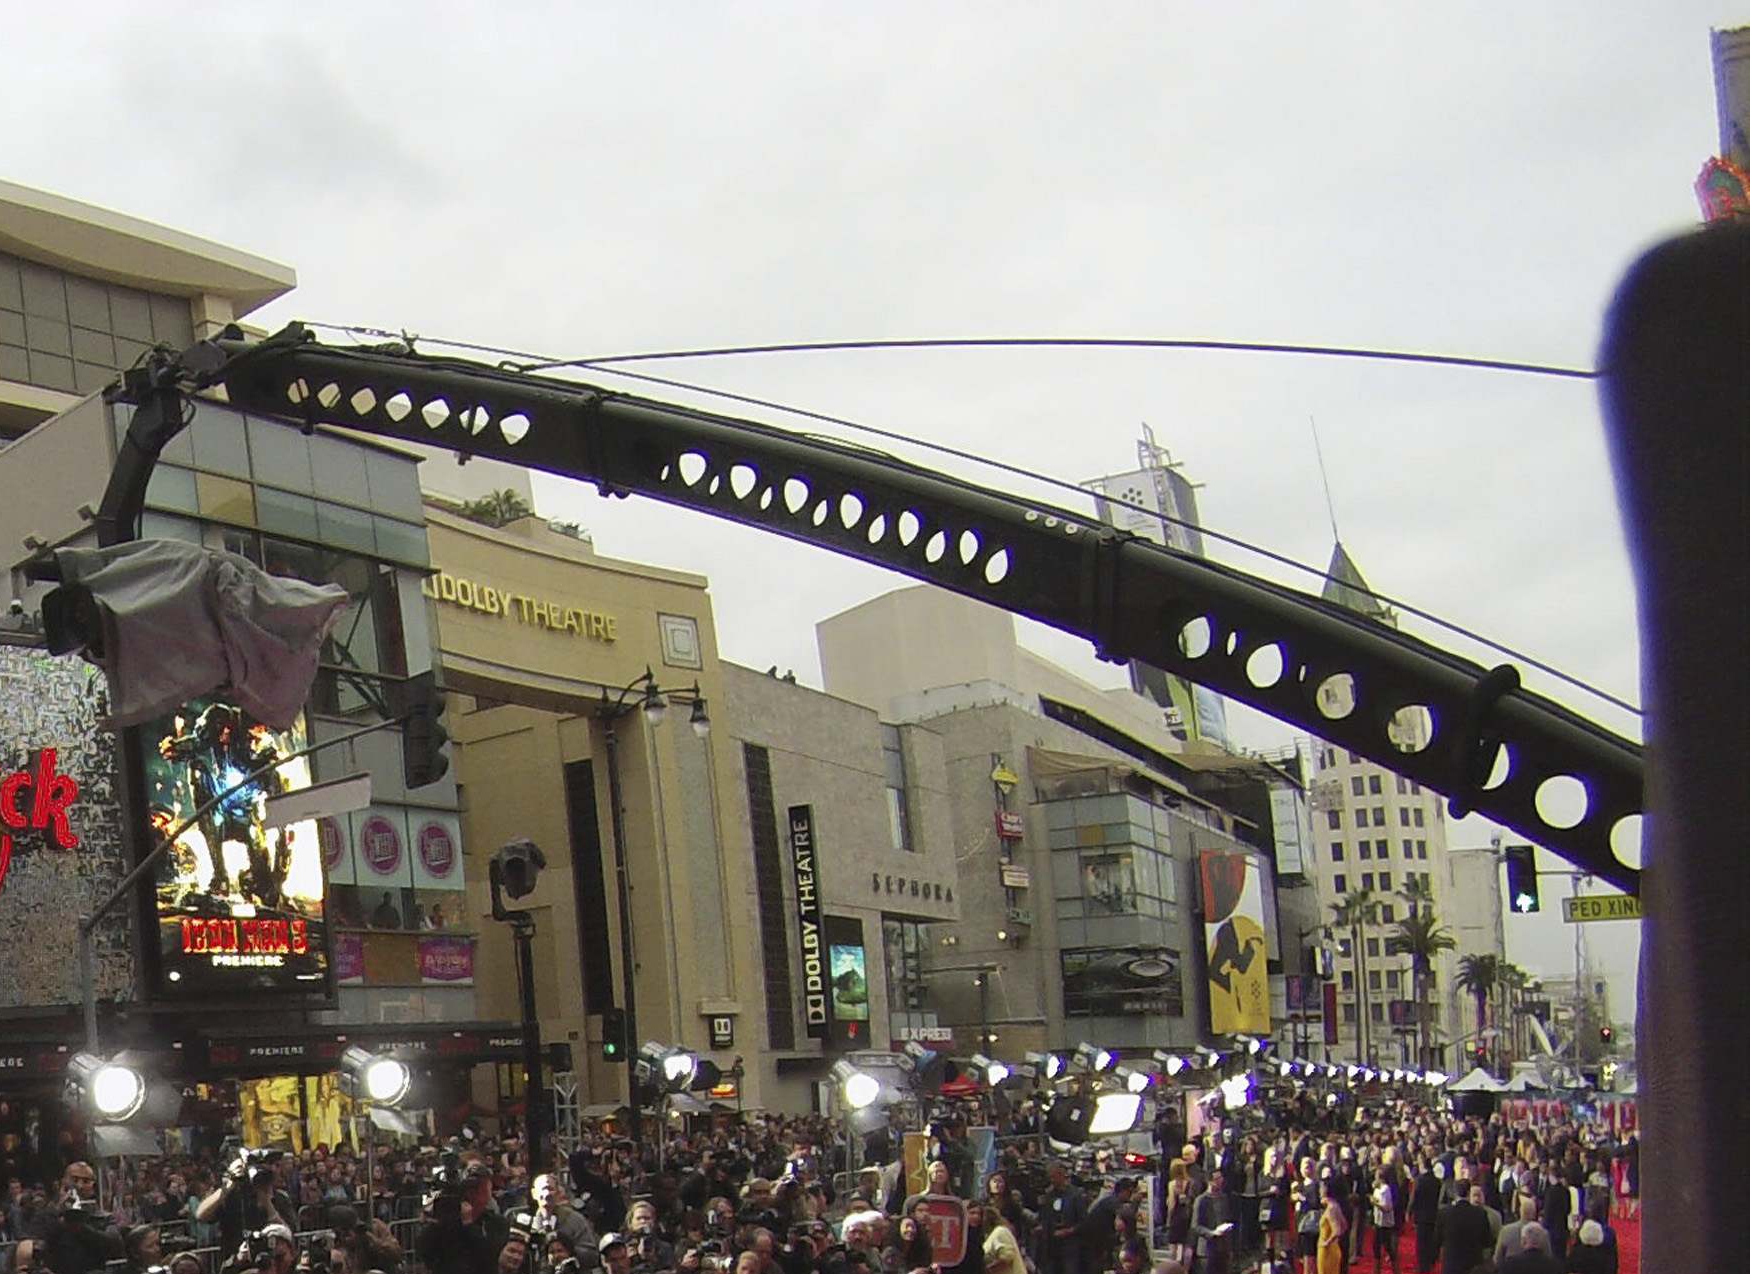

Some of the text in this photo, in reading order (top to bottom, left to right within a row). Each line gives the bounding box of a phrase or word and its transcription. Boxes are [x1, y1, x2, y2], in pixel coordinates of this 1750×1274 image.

[441, 574, 618, 641] DOLBY THEATRE
[793, 820, 824, 991] DOLBY THEATRE
[872, 873, 954, 902] SEPHORA
[1569, 901, 1602, 918] PED
